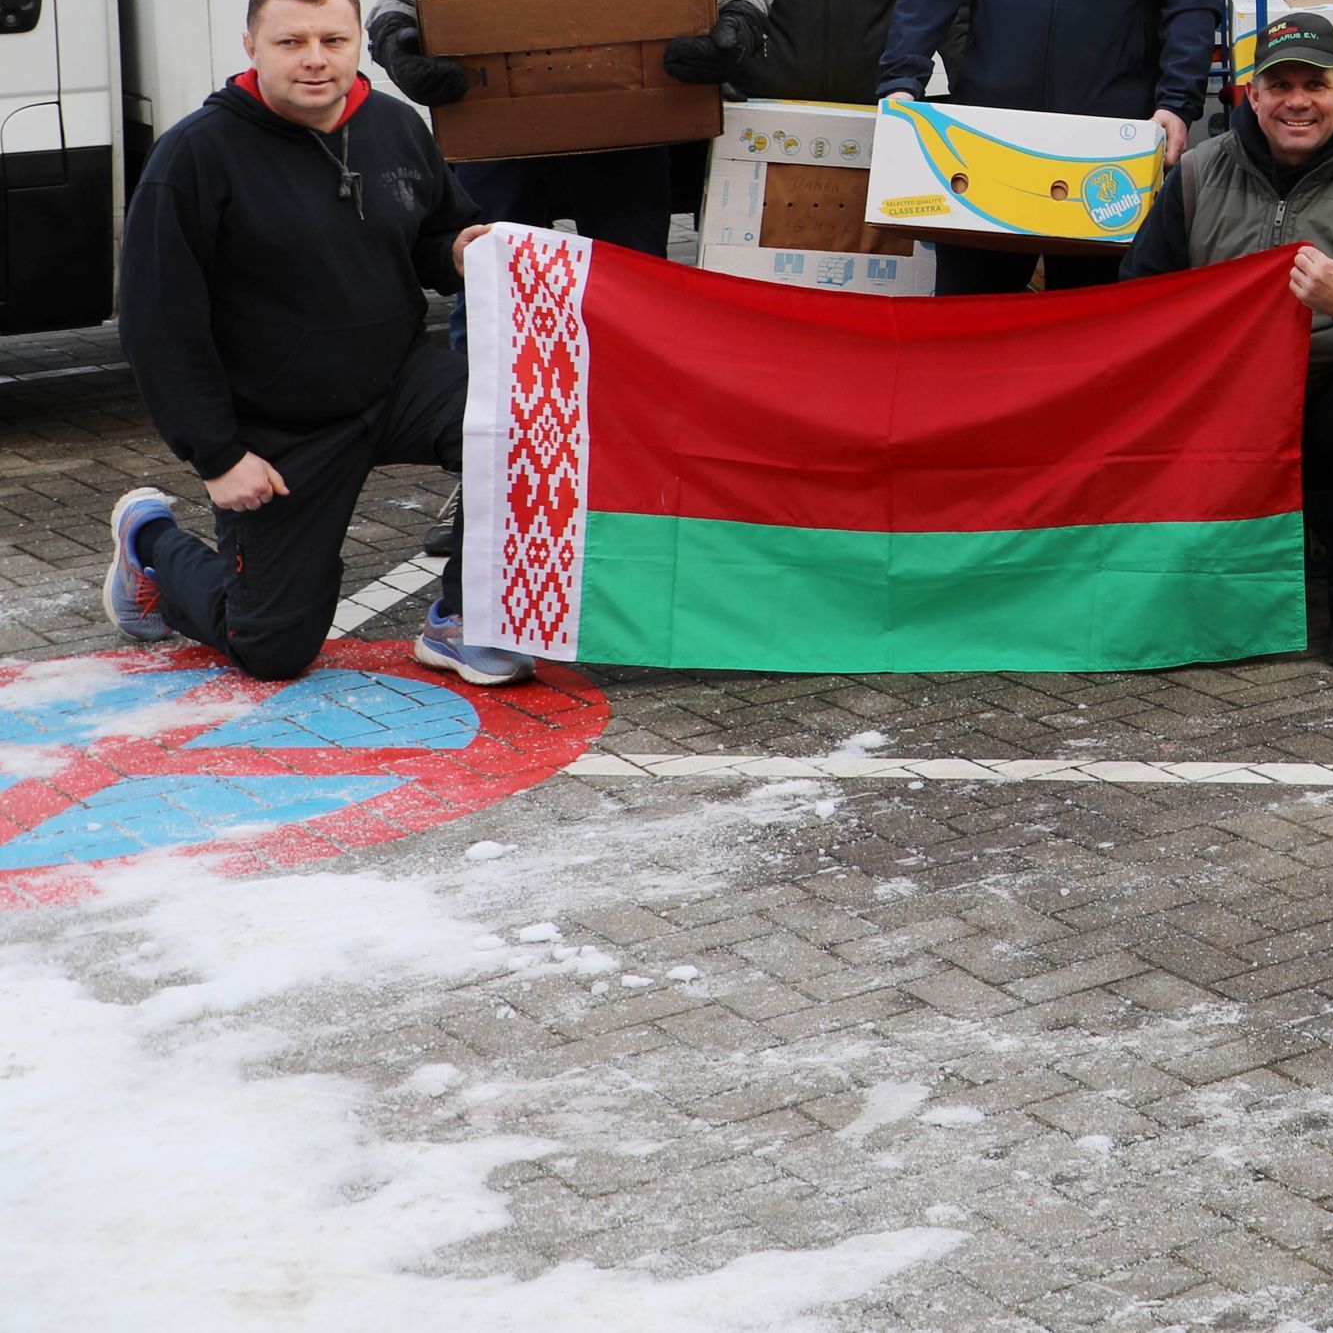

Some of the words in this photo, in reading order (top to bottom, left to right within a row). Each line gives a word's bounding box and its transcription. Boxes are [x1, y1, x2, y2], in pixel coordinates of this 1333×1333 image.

[1267, 32, 1301, 48] BELARUS
[1303, 31, 1320, 40] E.V.
[885, 198, 914, 207] SELECTED
[916, 196, 942, 206] QUALITY
[1089, 191, 1142, 225] Chiquita
[888, 206, 913, 216] CLASS
[914, 205, 942, 215] EXTRA
